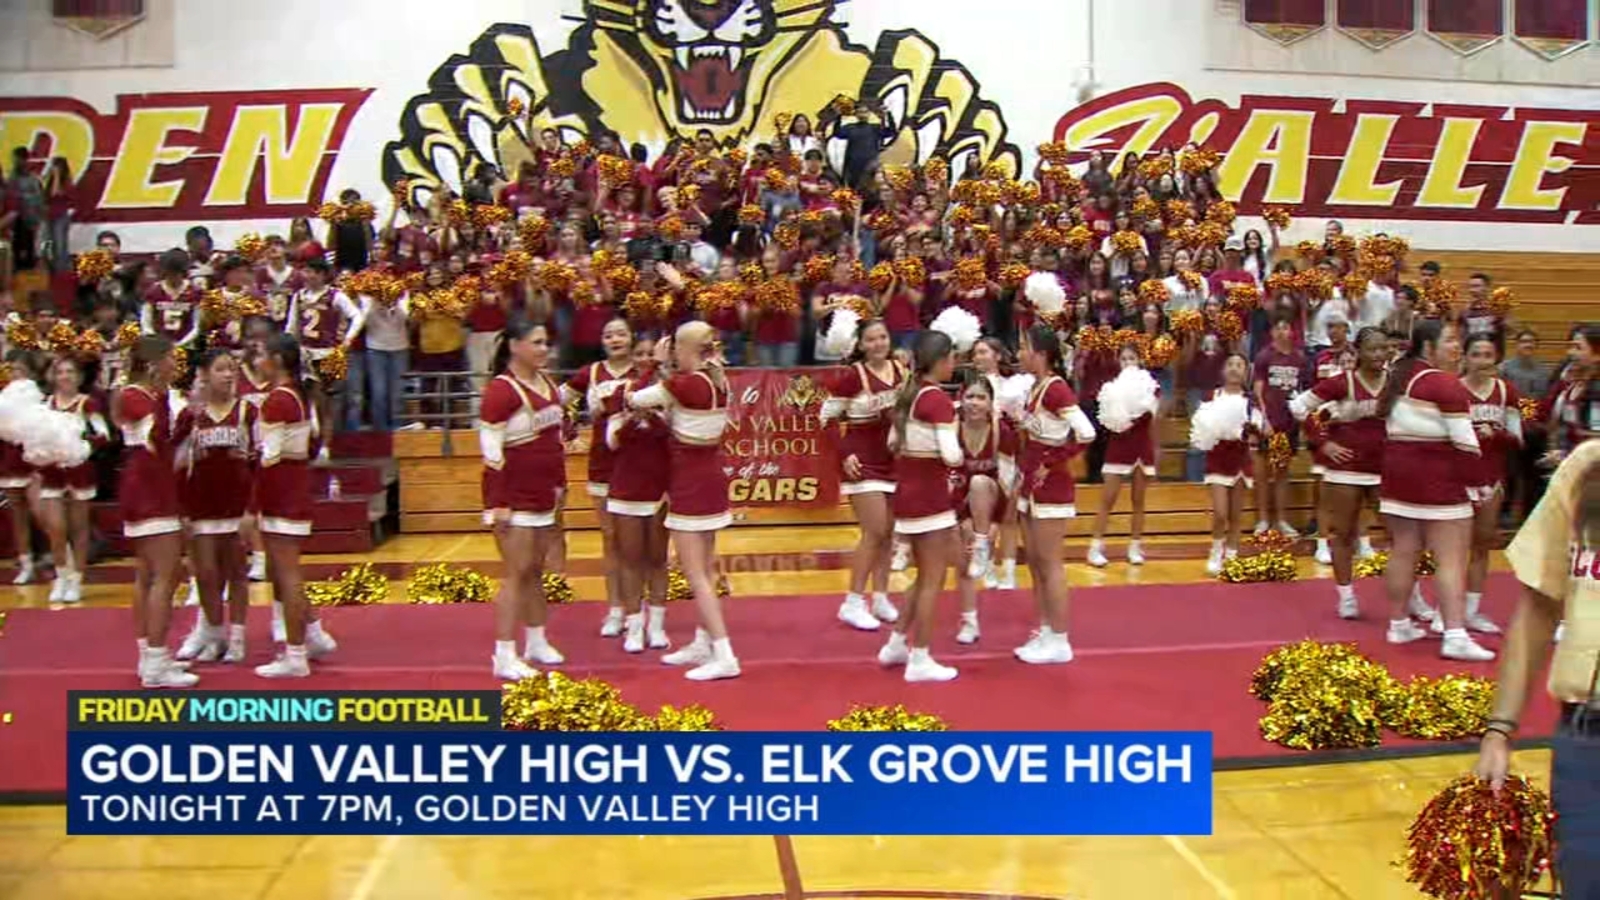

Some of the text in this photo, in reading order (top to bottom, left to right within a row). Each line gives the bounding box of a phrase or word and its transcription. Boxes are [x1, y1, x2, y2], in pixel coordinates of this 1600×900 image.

[163, 310, 181, 330] 5
[302, 309, 321, 339] 2
[723, 437, 820, 457] SCHOOL
[728, 477, 819, 502] GARS
